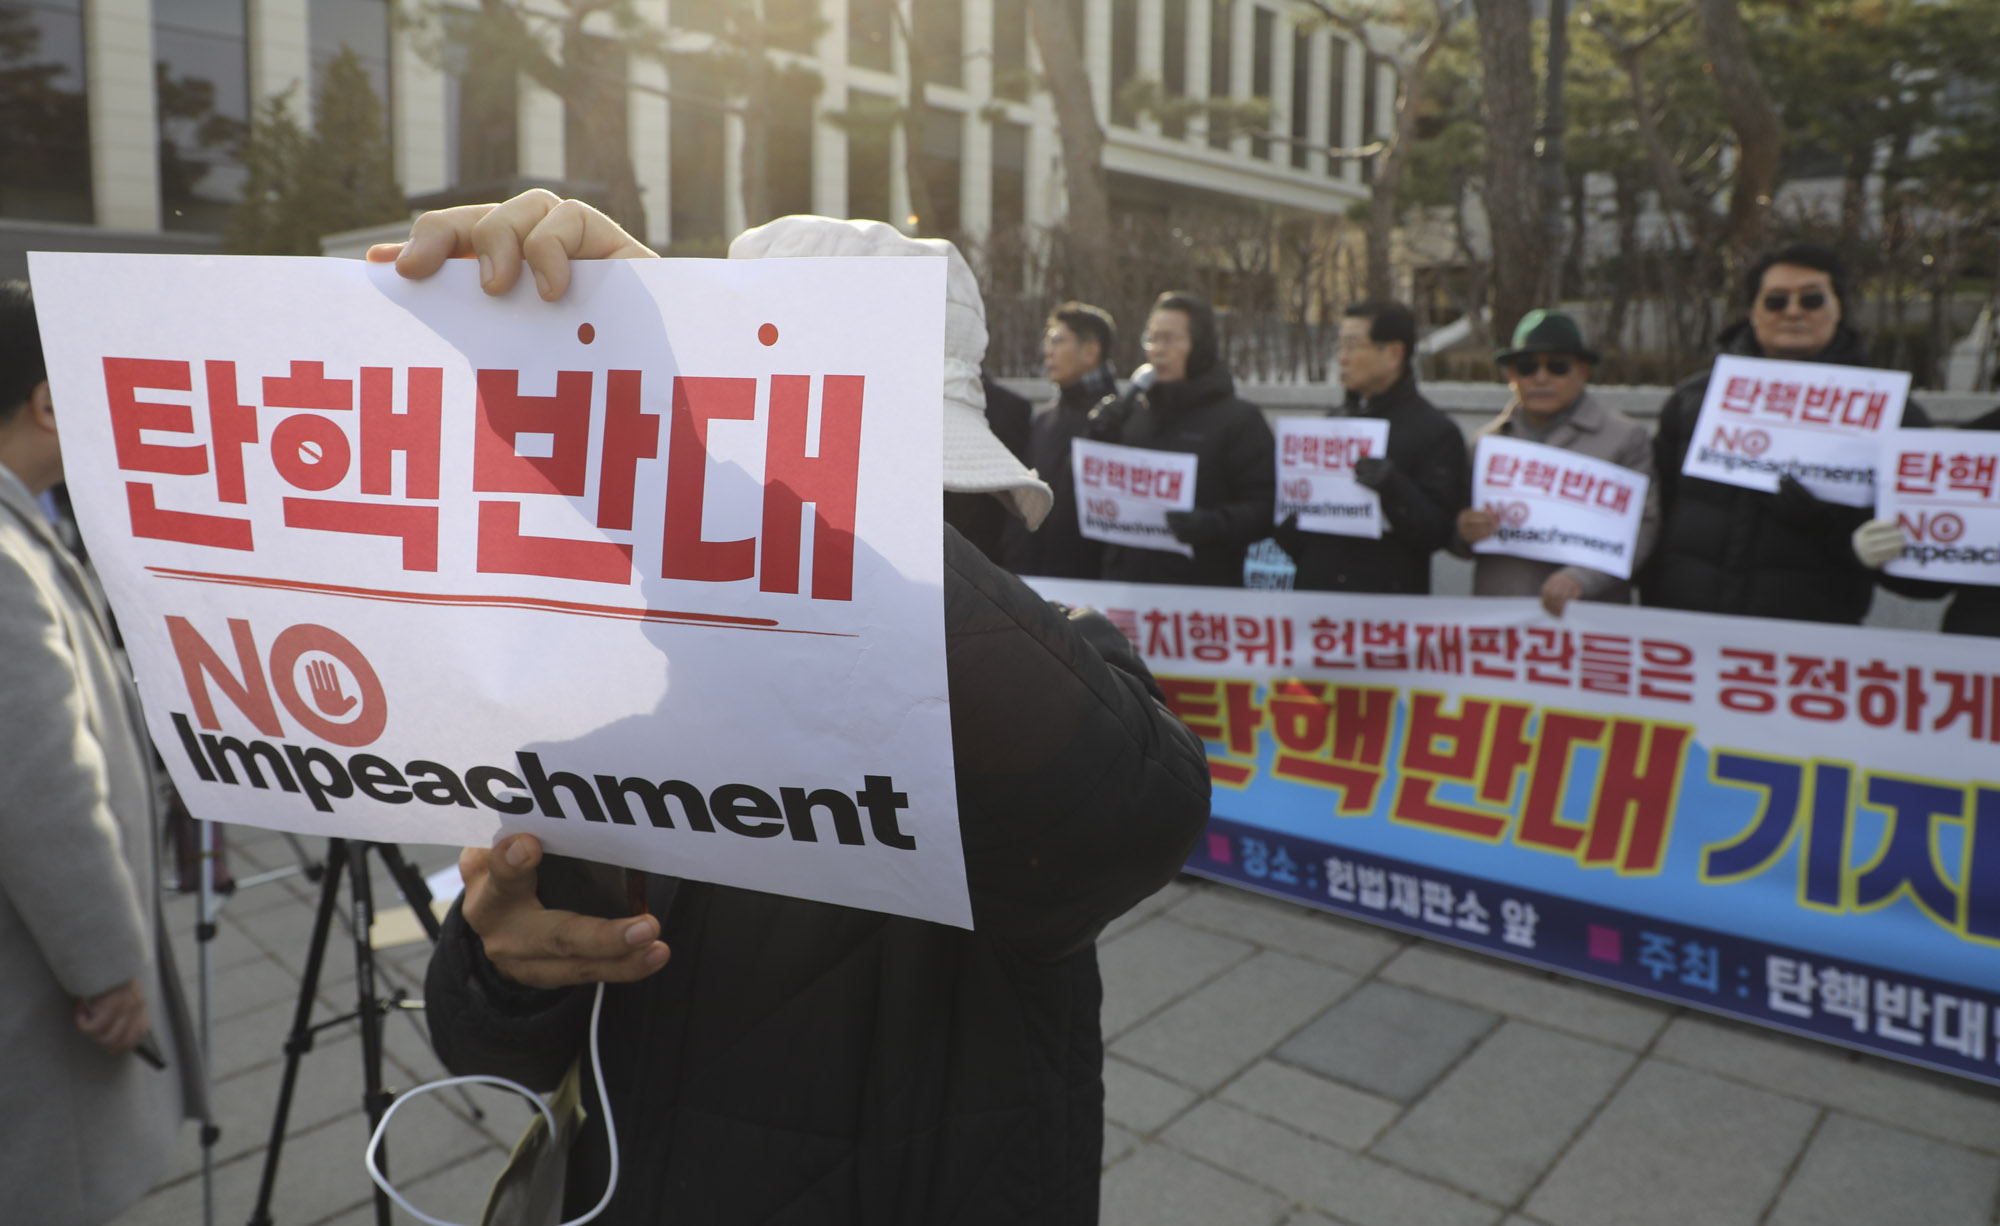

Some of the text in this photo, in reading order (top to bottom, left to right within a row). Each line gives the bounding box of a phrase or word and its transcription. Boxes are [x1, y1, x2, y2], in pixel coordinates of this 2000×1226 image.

[1711, 424, 1771, 457] NO
[1720, 376, 1889, 430] 탄핵반대
[103, 357, 866, 601] 탄핵반대
[1485, 453, 1632, 515] 탄핵반대
[1895, 511, 1964, 543] NO
[164, 615, 388, 748] NO
[1310, 616, 1695, 704] 헌법재판관들은
[1718, 645, 2000, 744] 공정하게
[170, 712, 916, 852] Impeachment
[1153, 672, 1696, 877] 탄핵반대
[1325, 856, 1492, 937] 헌법재판소
[1500, 898, 1540, 949] 앞
[1638, 930, 1719, 994] 주최
[1766, 954, 2000, 1066] 탄핵반대
